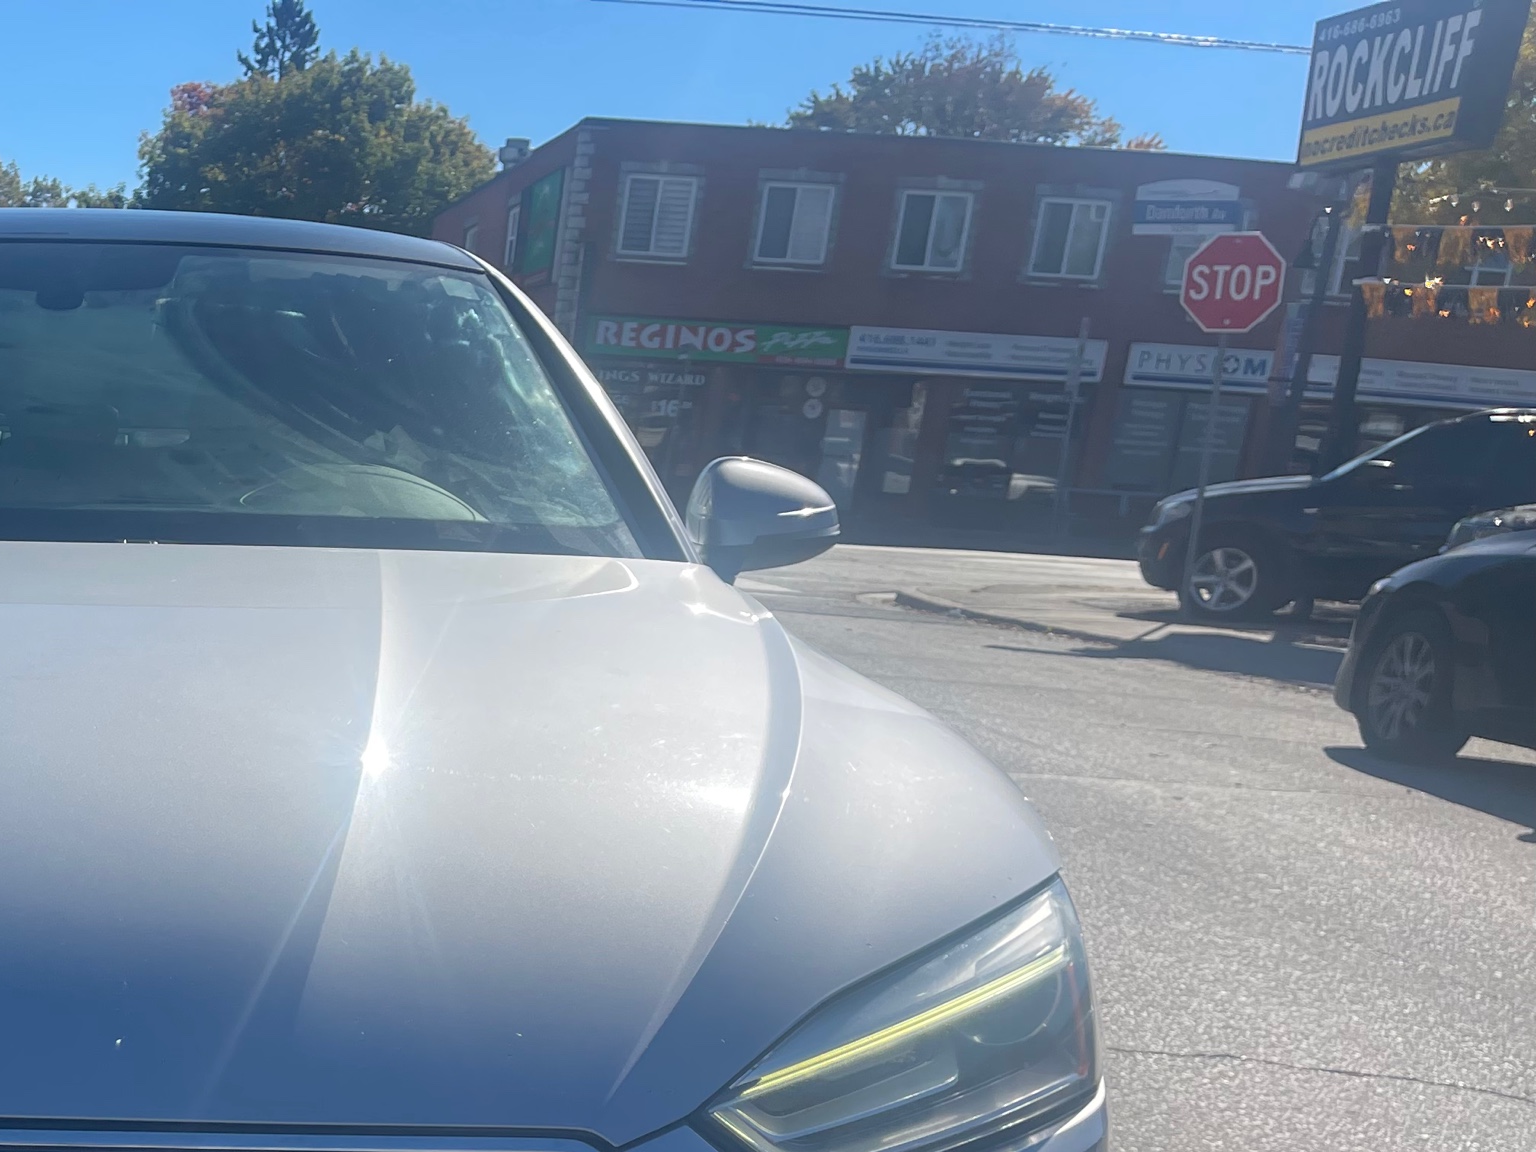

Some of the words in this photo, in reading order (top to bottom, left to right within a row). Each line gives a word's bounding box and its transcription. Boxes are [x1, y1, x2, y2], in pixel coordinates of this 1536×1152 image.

[1307, 9, 1482, 121] ROCKCLIFF
[1303, 110, 1457, 156] nocreditchecks.ca
[1189, 264, 1277, 301] STOP
[595, 320, 758, 354] REGINOS
[595, 369, 640, 383] INGS
